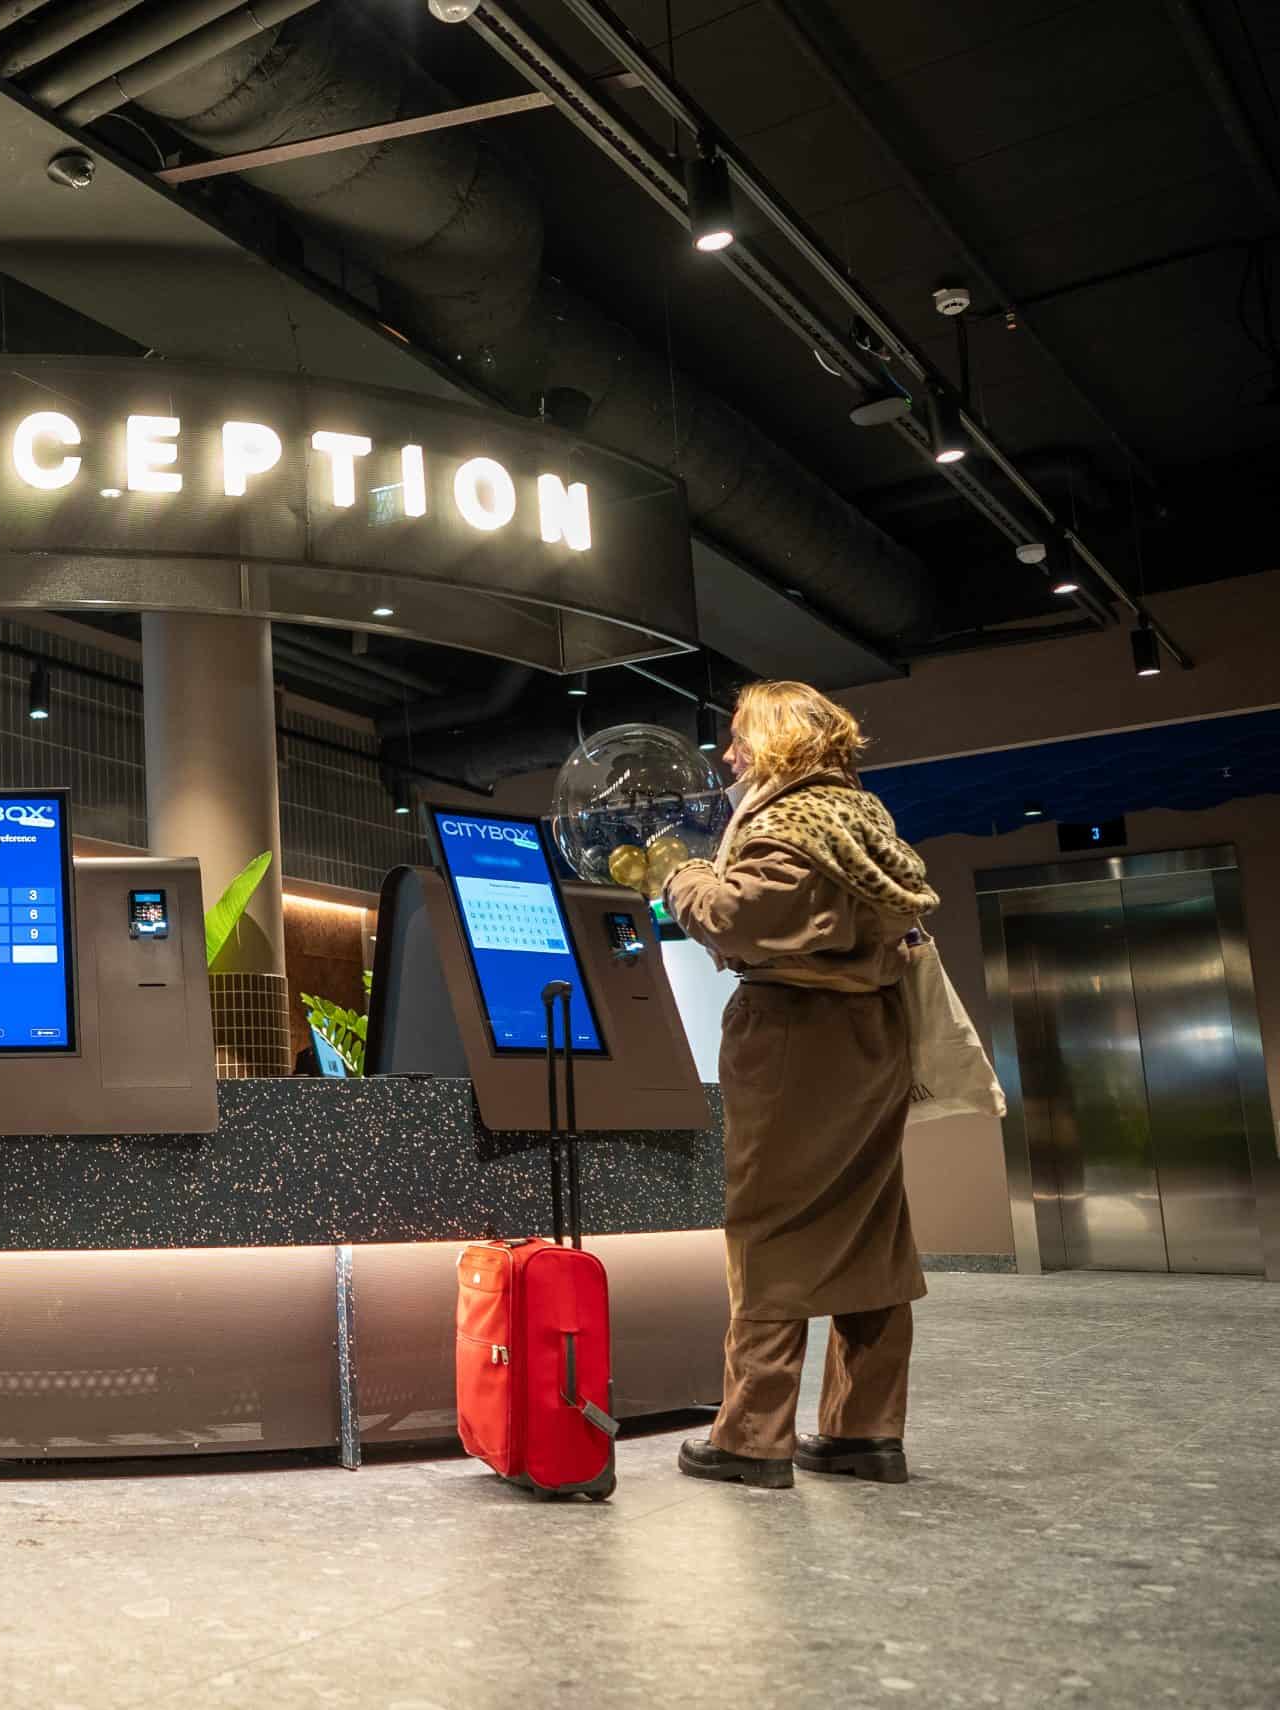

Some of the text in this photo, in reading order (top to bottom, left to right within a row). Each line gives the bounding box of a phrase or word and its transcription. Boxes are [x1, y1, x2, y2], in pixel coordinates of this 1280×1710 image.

[442, 820, 529, 841] CITYBOX
[1091, 827, 1099, 840] 3
[29, 889, 38, 901] 3
[29, 908, 39, 921] 6
[29, 928, 39, 940] 9
